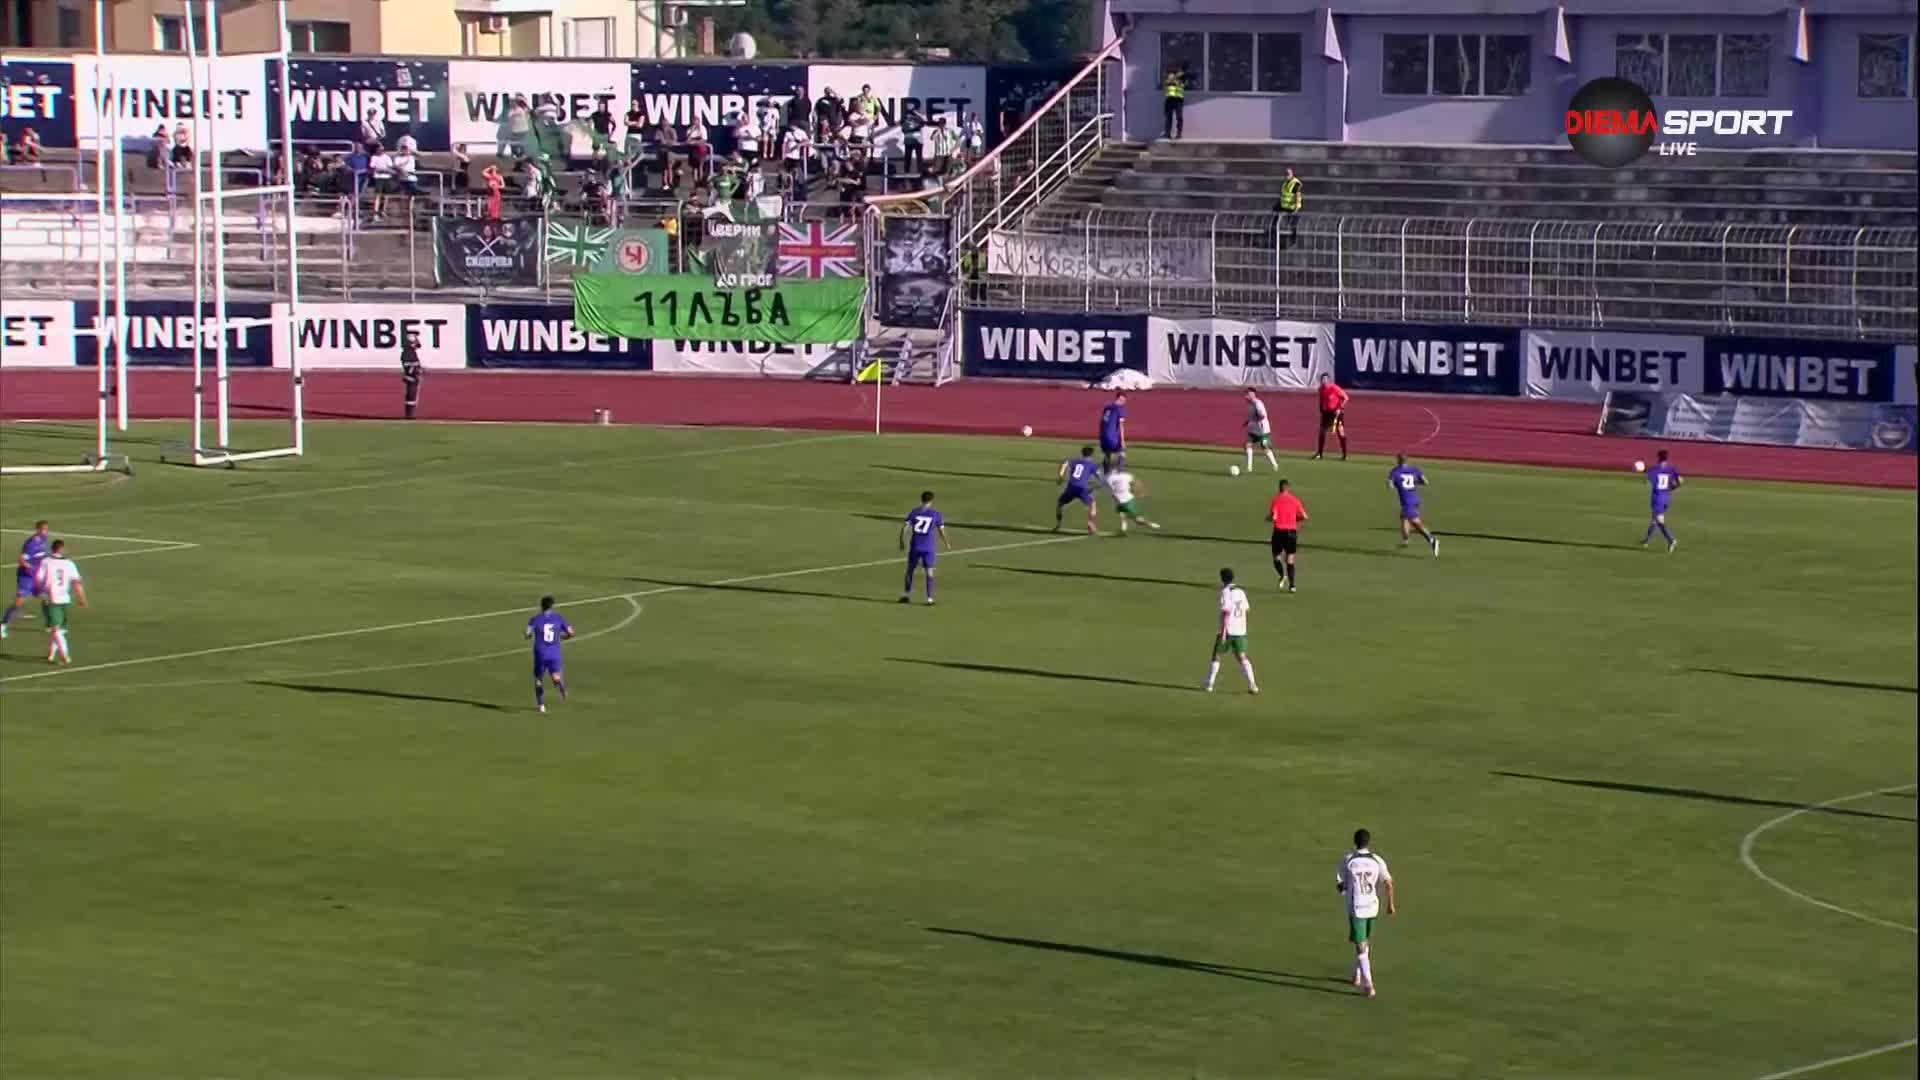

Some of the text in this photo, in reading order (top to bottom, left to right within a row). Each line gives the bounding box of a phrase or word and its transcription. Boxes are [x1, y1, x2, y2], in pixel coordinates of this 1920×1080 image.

[288, 89, 436, 122] WINBET
[981, 327, 1131, 364] WINBET
[1168, 333, 1318, 369] WINBET
[1352, 337, 1504, 378] WINBET
[1538, 346, 1687, 386] WINBET
[1720, 353, 1878, 395] WINBET
[914, 515, 933, 534] 27
